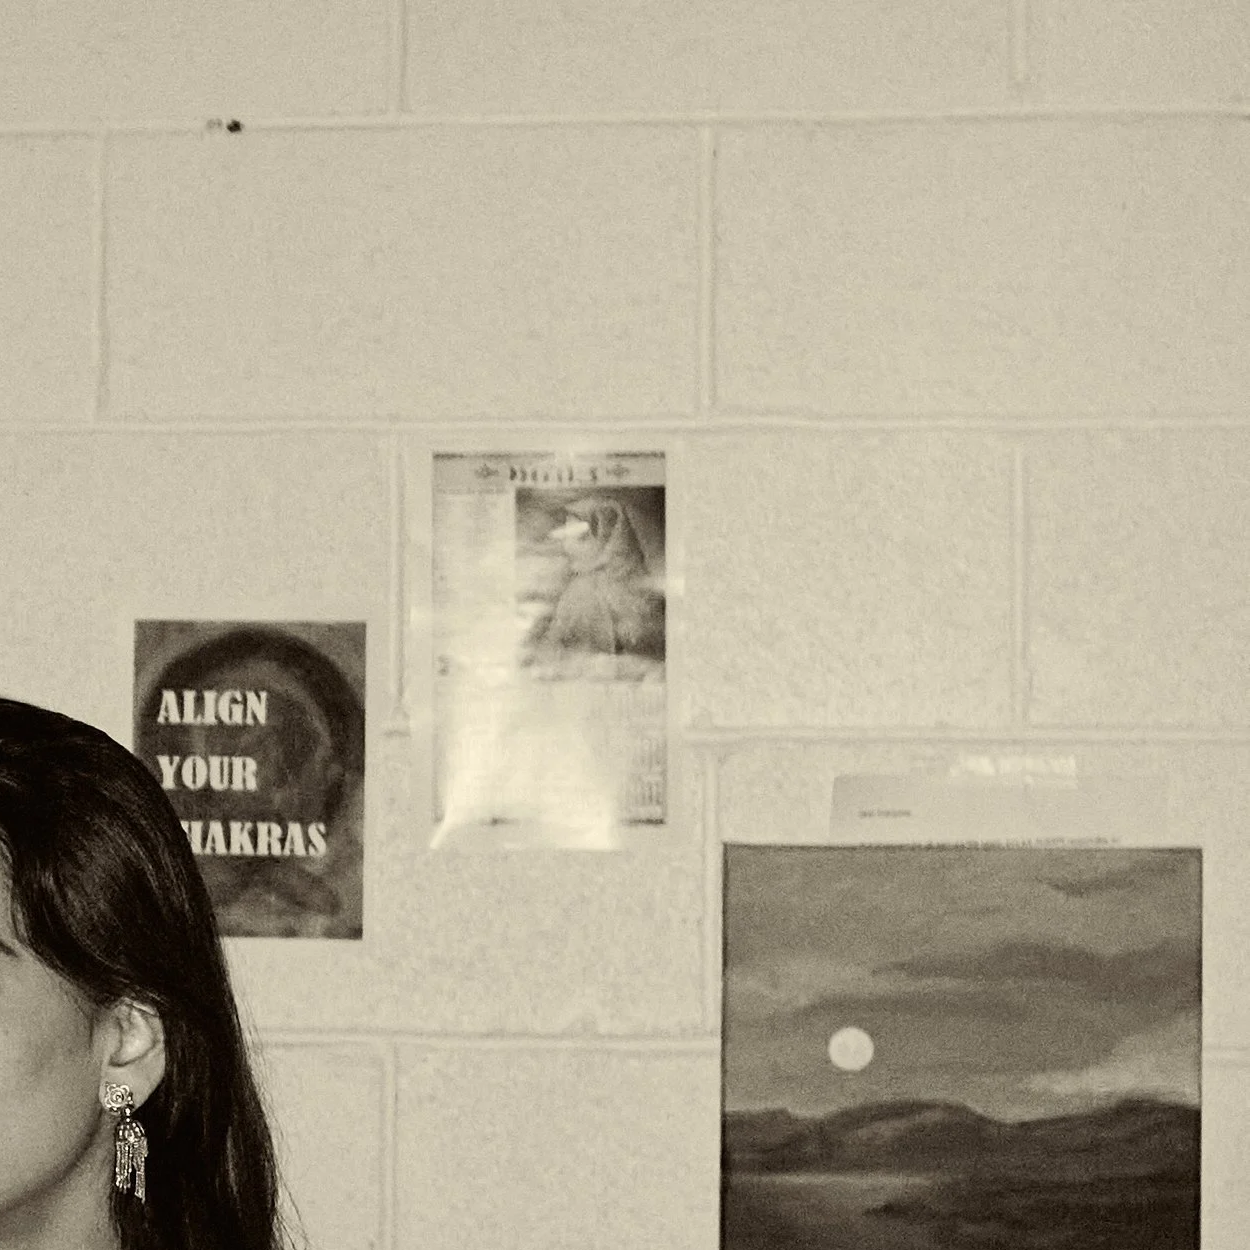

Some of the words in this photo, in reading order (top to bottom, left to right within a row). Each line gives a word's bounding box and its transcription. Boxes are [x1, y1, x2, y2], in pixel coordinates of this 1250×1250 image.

[157, 690, 267, 726] ALIGN
[157, 755, 257, 791] YOUR
[181, 820, 327, 857] HAKRAS
